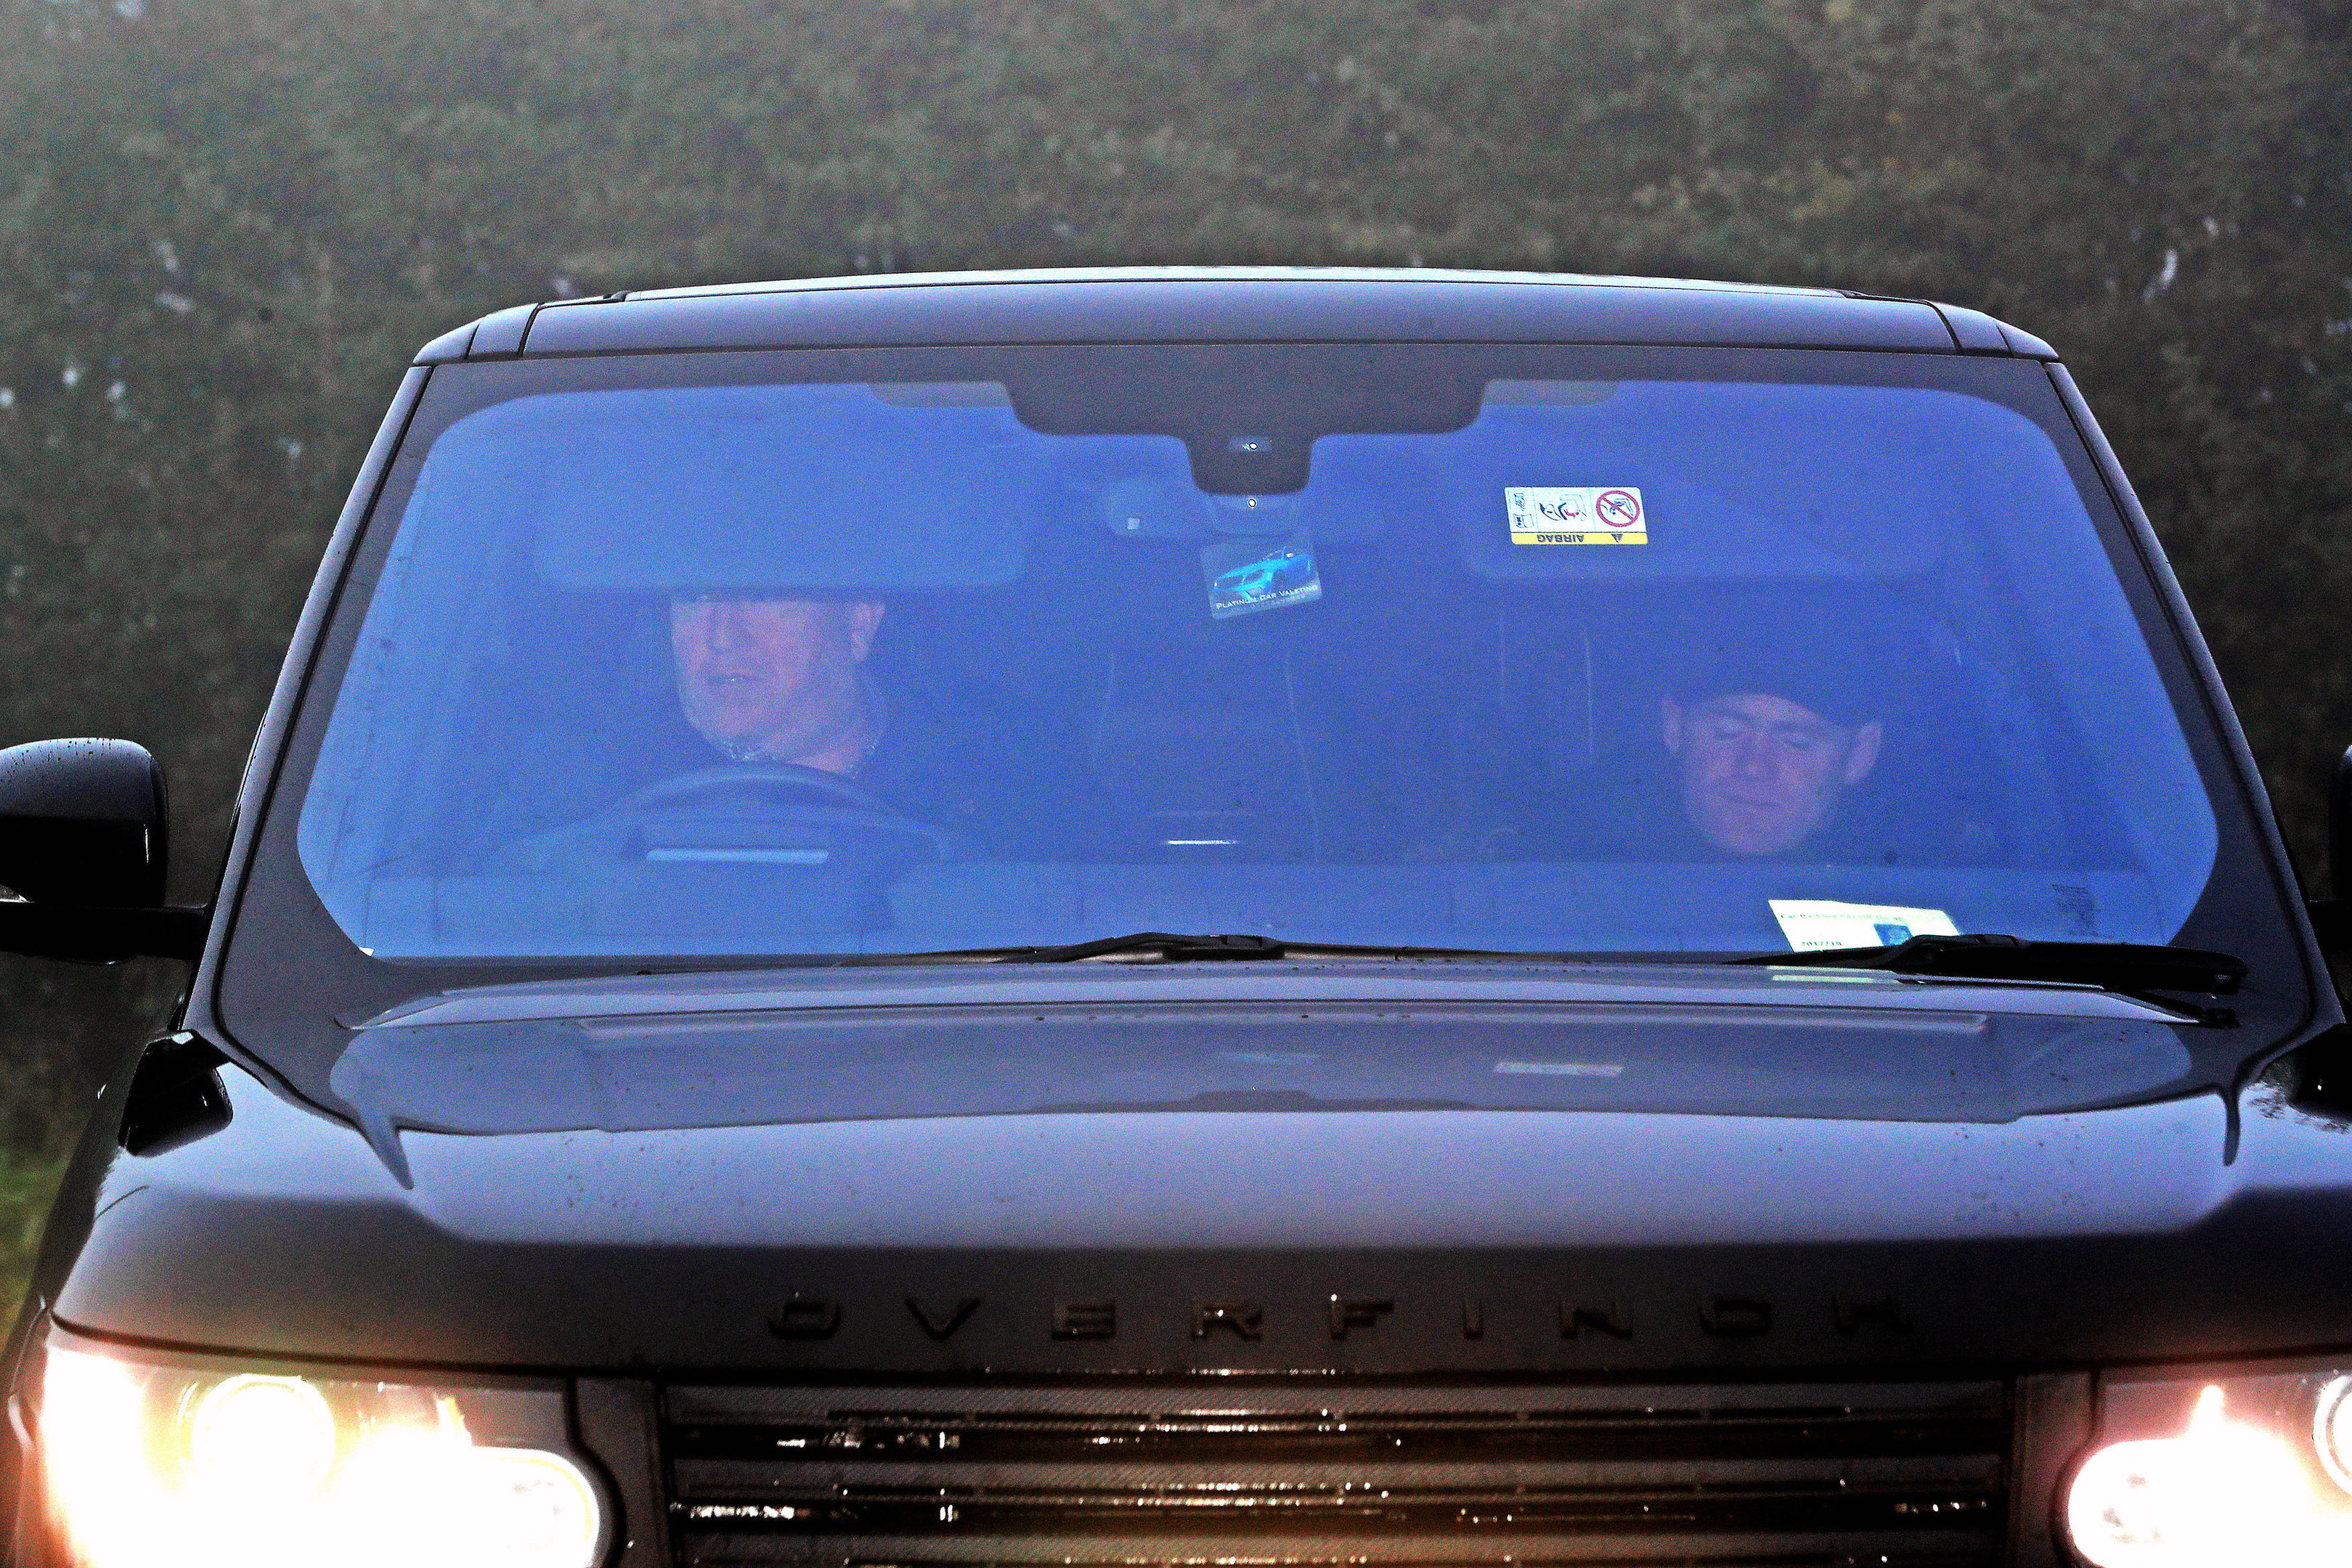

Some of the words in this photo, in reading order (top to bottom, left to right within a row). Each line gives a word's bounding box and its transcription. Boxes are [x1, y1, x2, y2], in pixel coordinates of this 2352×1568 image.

[1537, 534, 1584, 543] AIRBAG
[1260, 592, 1277, 602] CAR
[766, 1294, 1915, 1340] OVERFINCH
